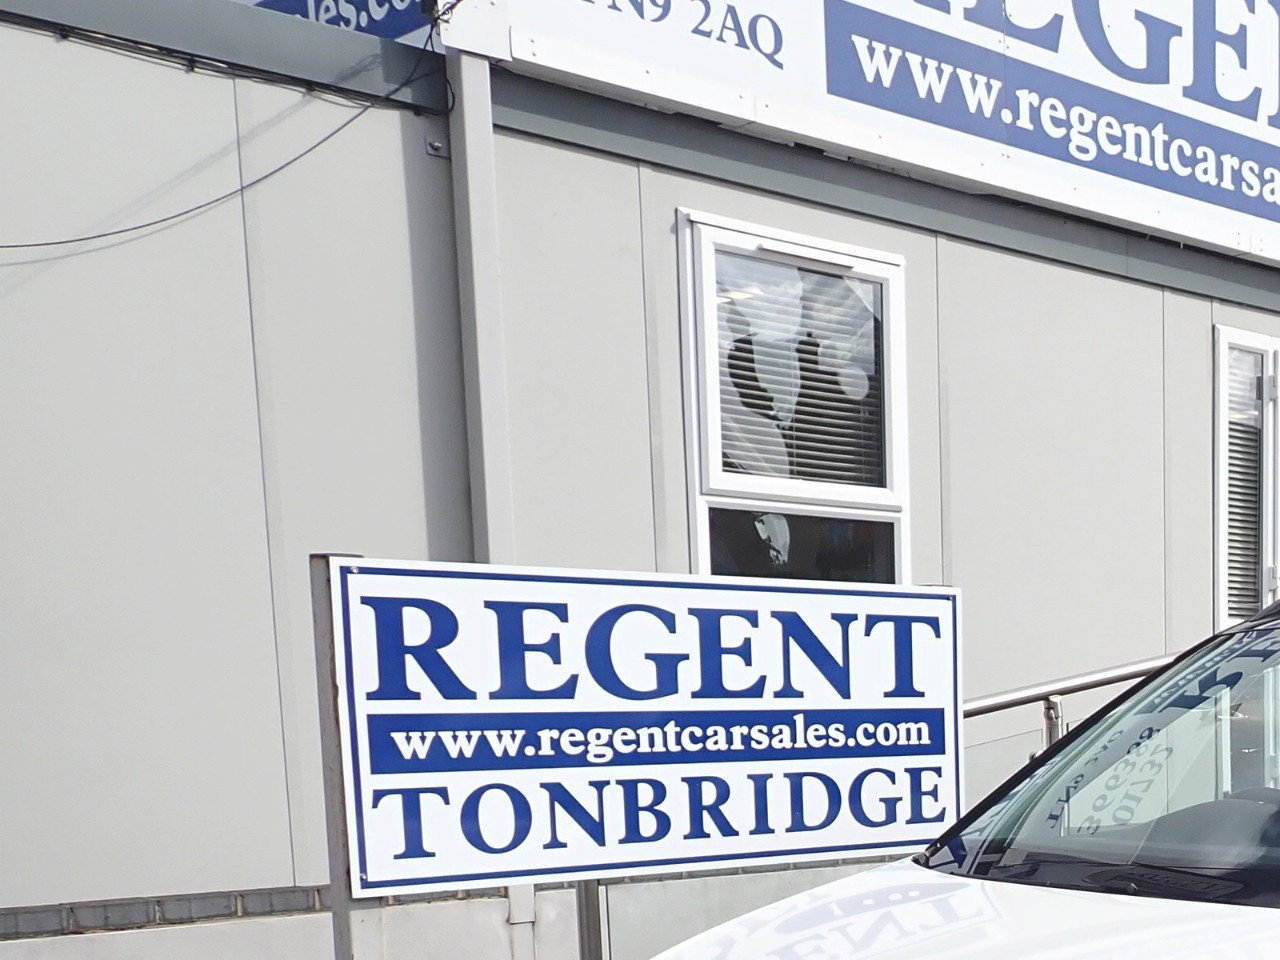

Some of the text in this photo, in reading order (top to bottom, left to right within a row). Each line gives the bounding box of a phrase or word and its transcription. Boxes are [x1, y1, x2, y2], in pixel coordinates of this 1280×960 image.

[691, 0, 784, 70] 2AQ
[360, 595, 942, 701] REGENT
[390, 713, 931, 764] www.regentcarsales.com
[371, 766, 947, 860] TONBRIDGE
